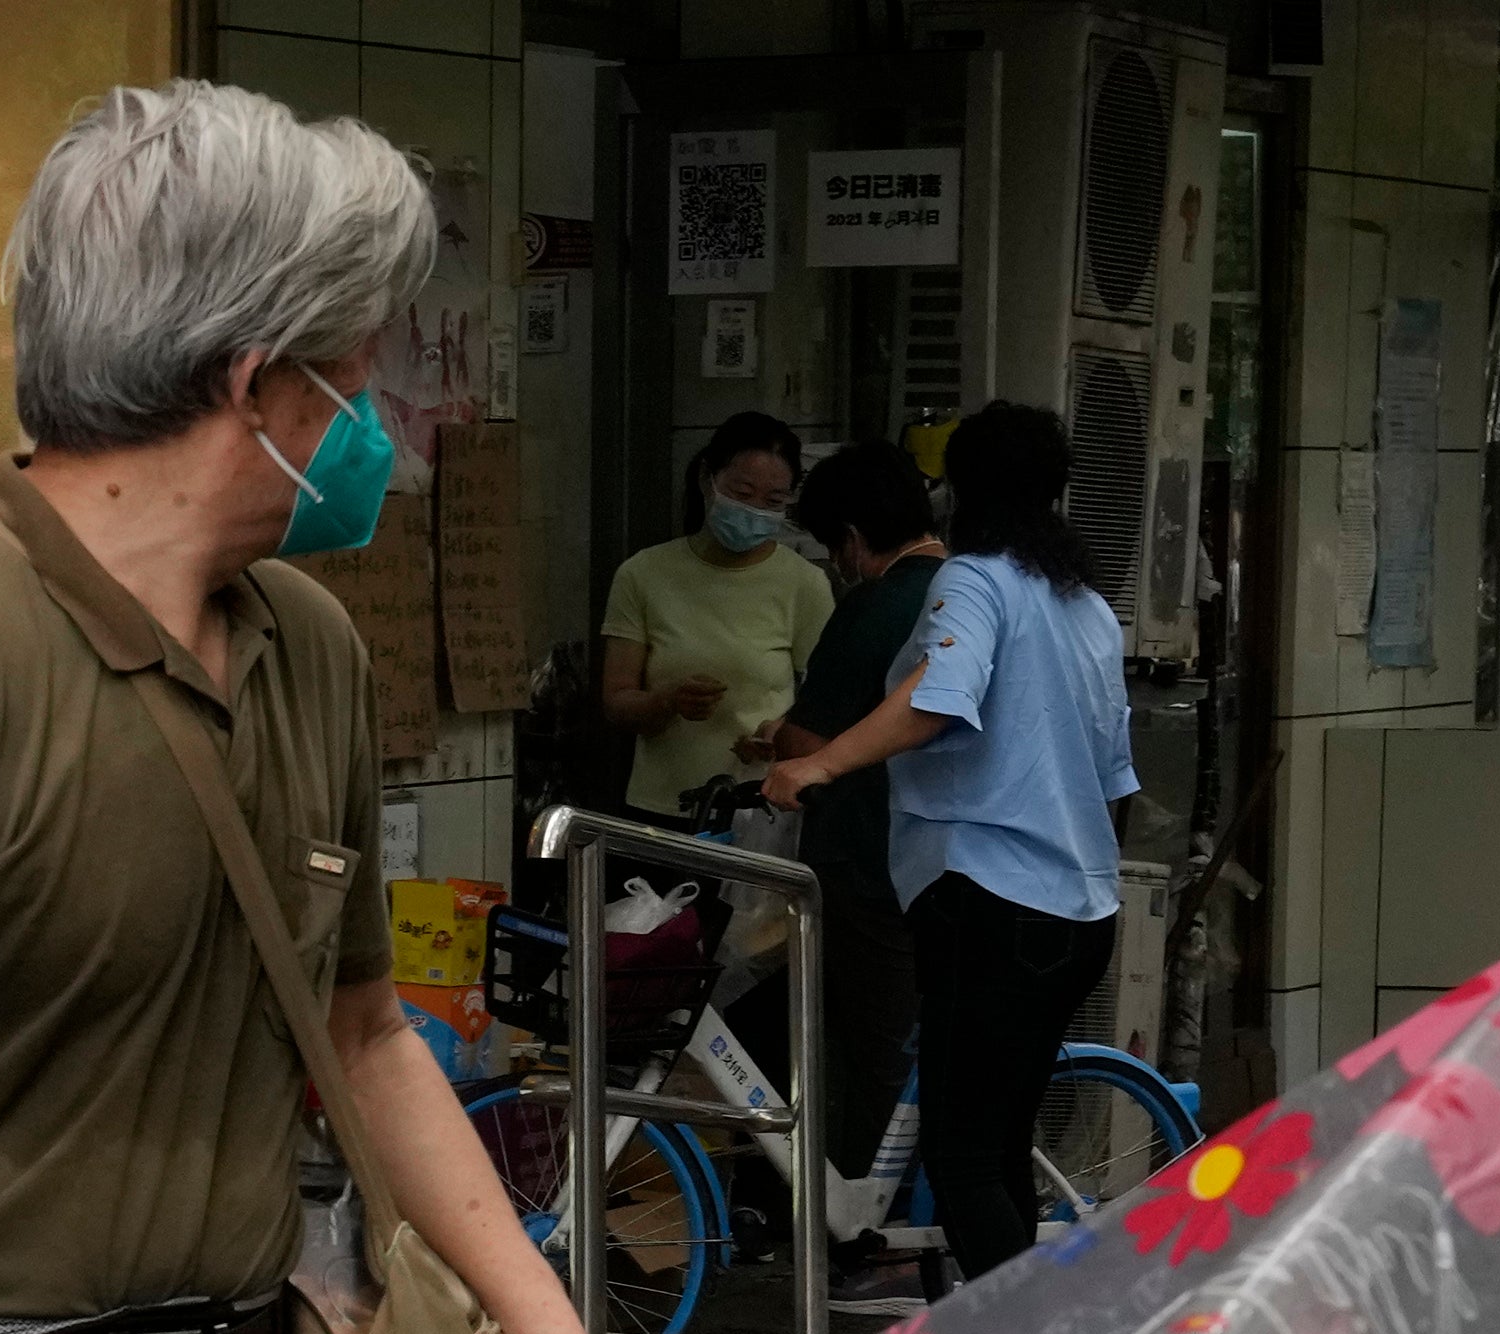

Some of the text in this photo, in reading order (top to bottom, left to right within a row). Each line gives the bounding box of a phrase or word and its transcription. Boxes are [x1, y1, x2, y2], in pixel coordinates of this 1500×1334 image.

[826, 174, 942, 200] 今日已消毒
[721, 1053, 749, 1086] 支付宝
